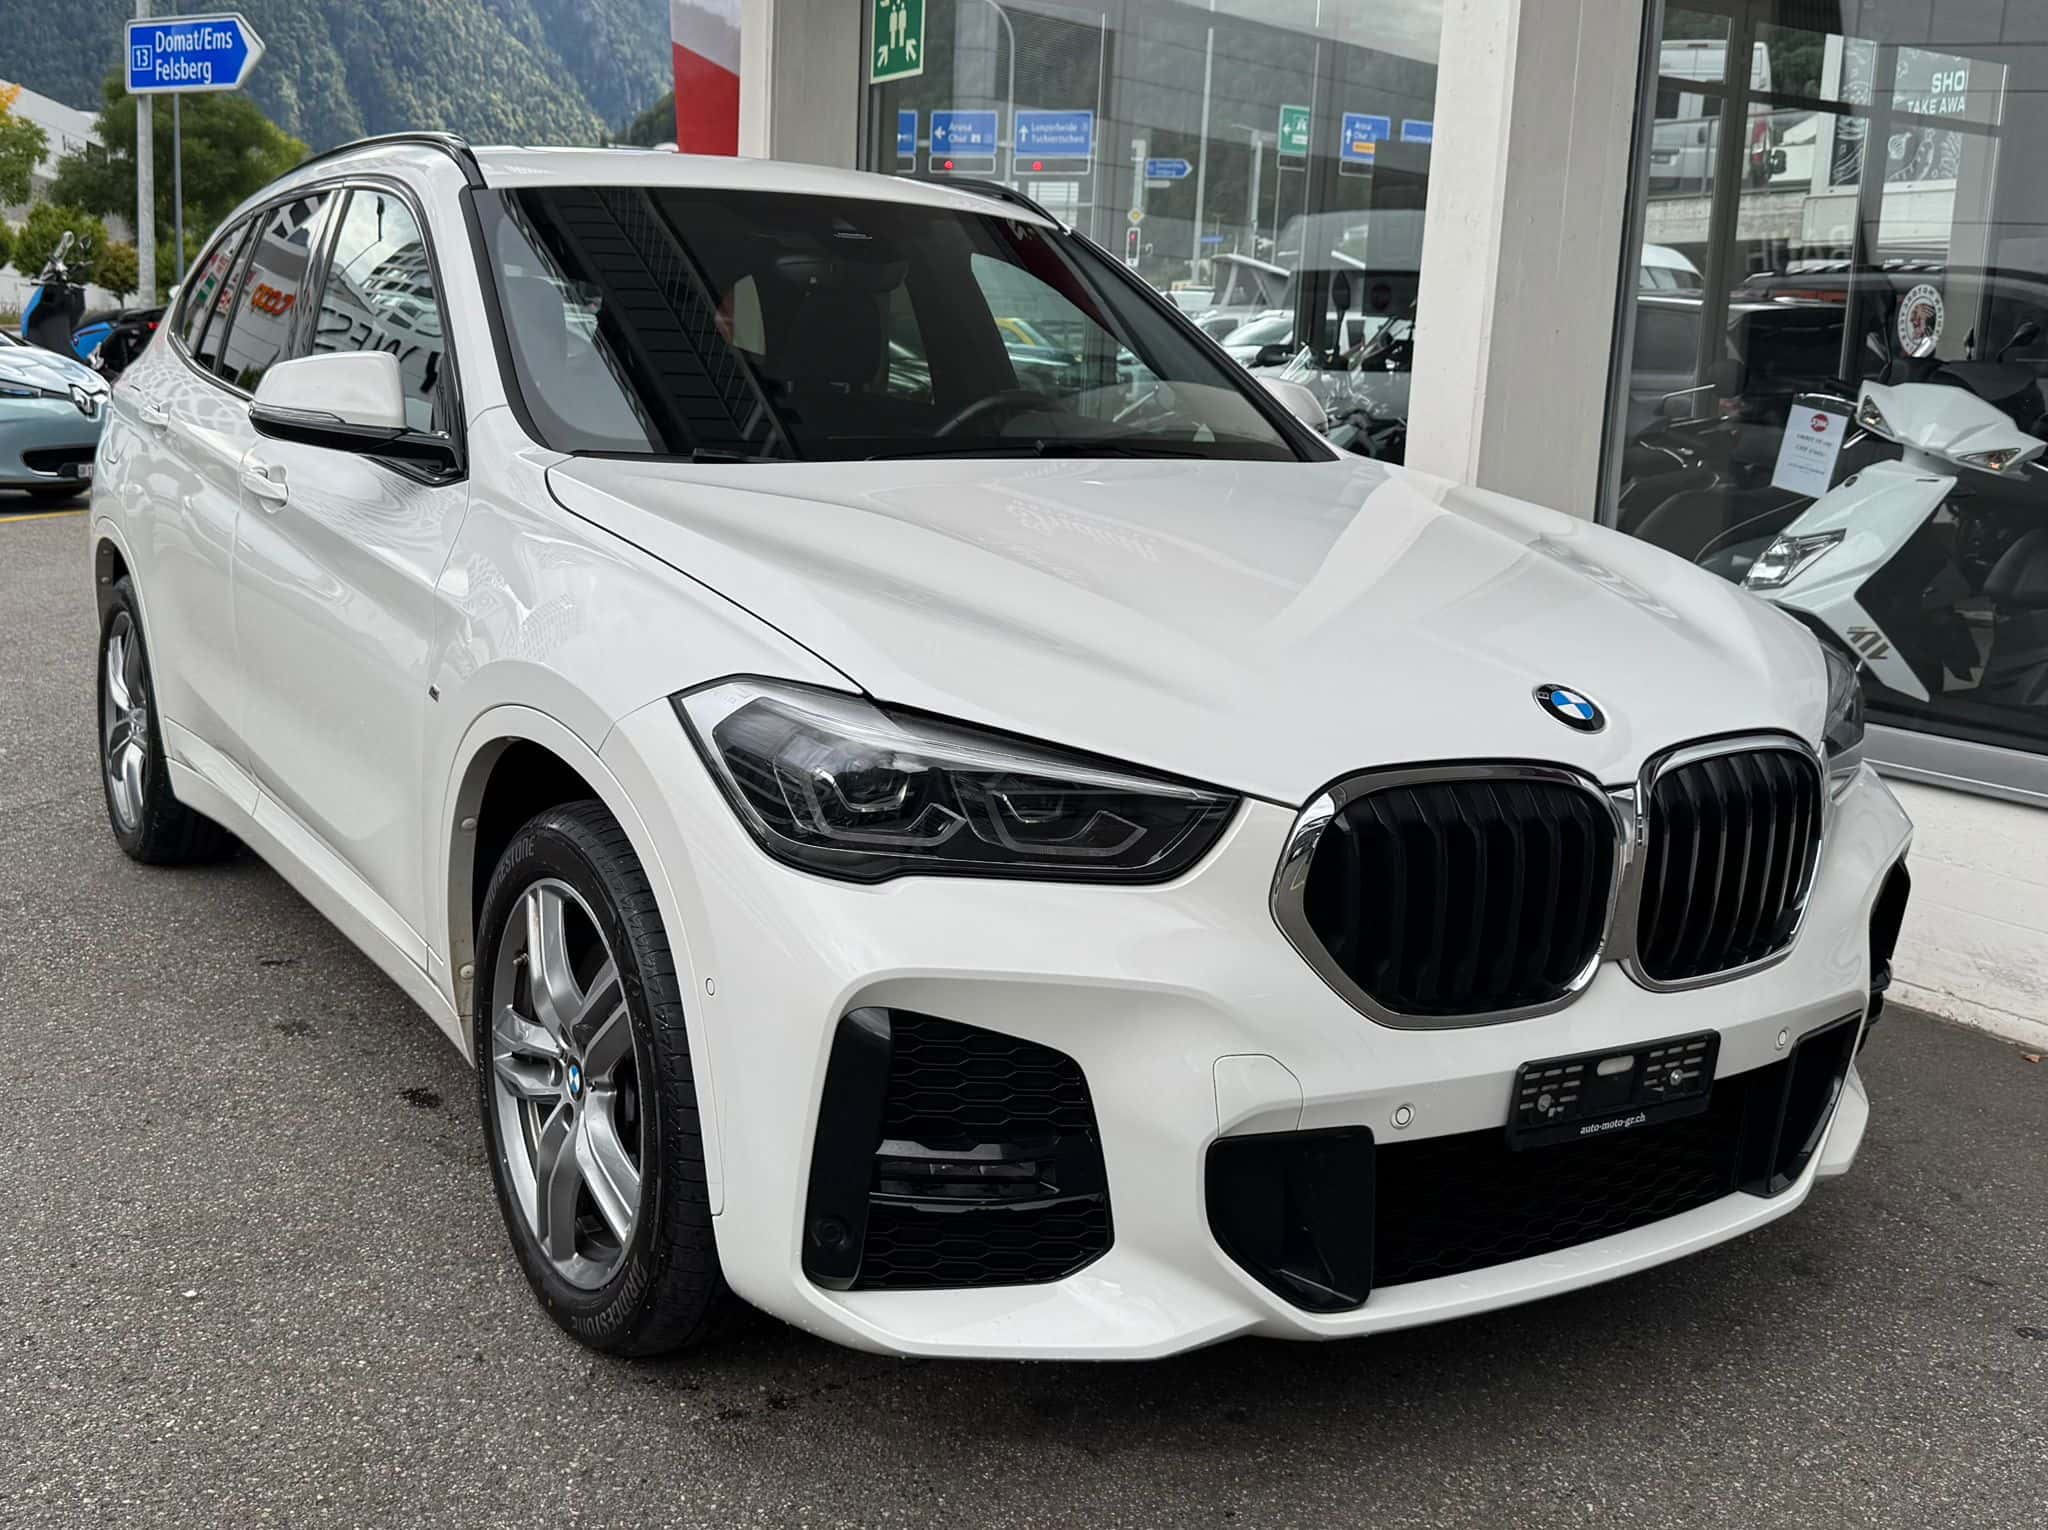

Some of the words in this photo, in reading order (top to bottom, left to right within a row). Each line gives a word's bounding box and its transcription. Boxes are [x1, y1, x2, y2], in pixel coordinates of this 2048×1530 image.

[155, 28, 232, 53] Domat/Ems
[136, 49, 149, 67] 13
[155, 56, 212, 85] Felsberg
[1907, 98, 1937, 115] TAKE
[1580, 1112, 1646, 1135] auto-moto-gr.ch
